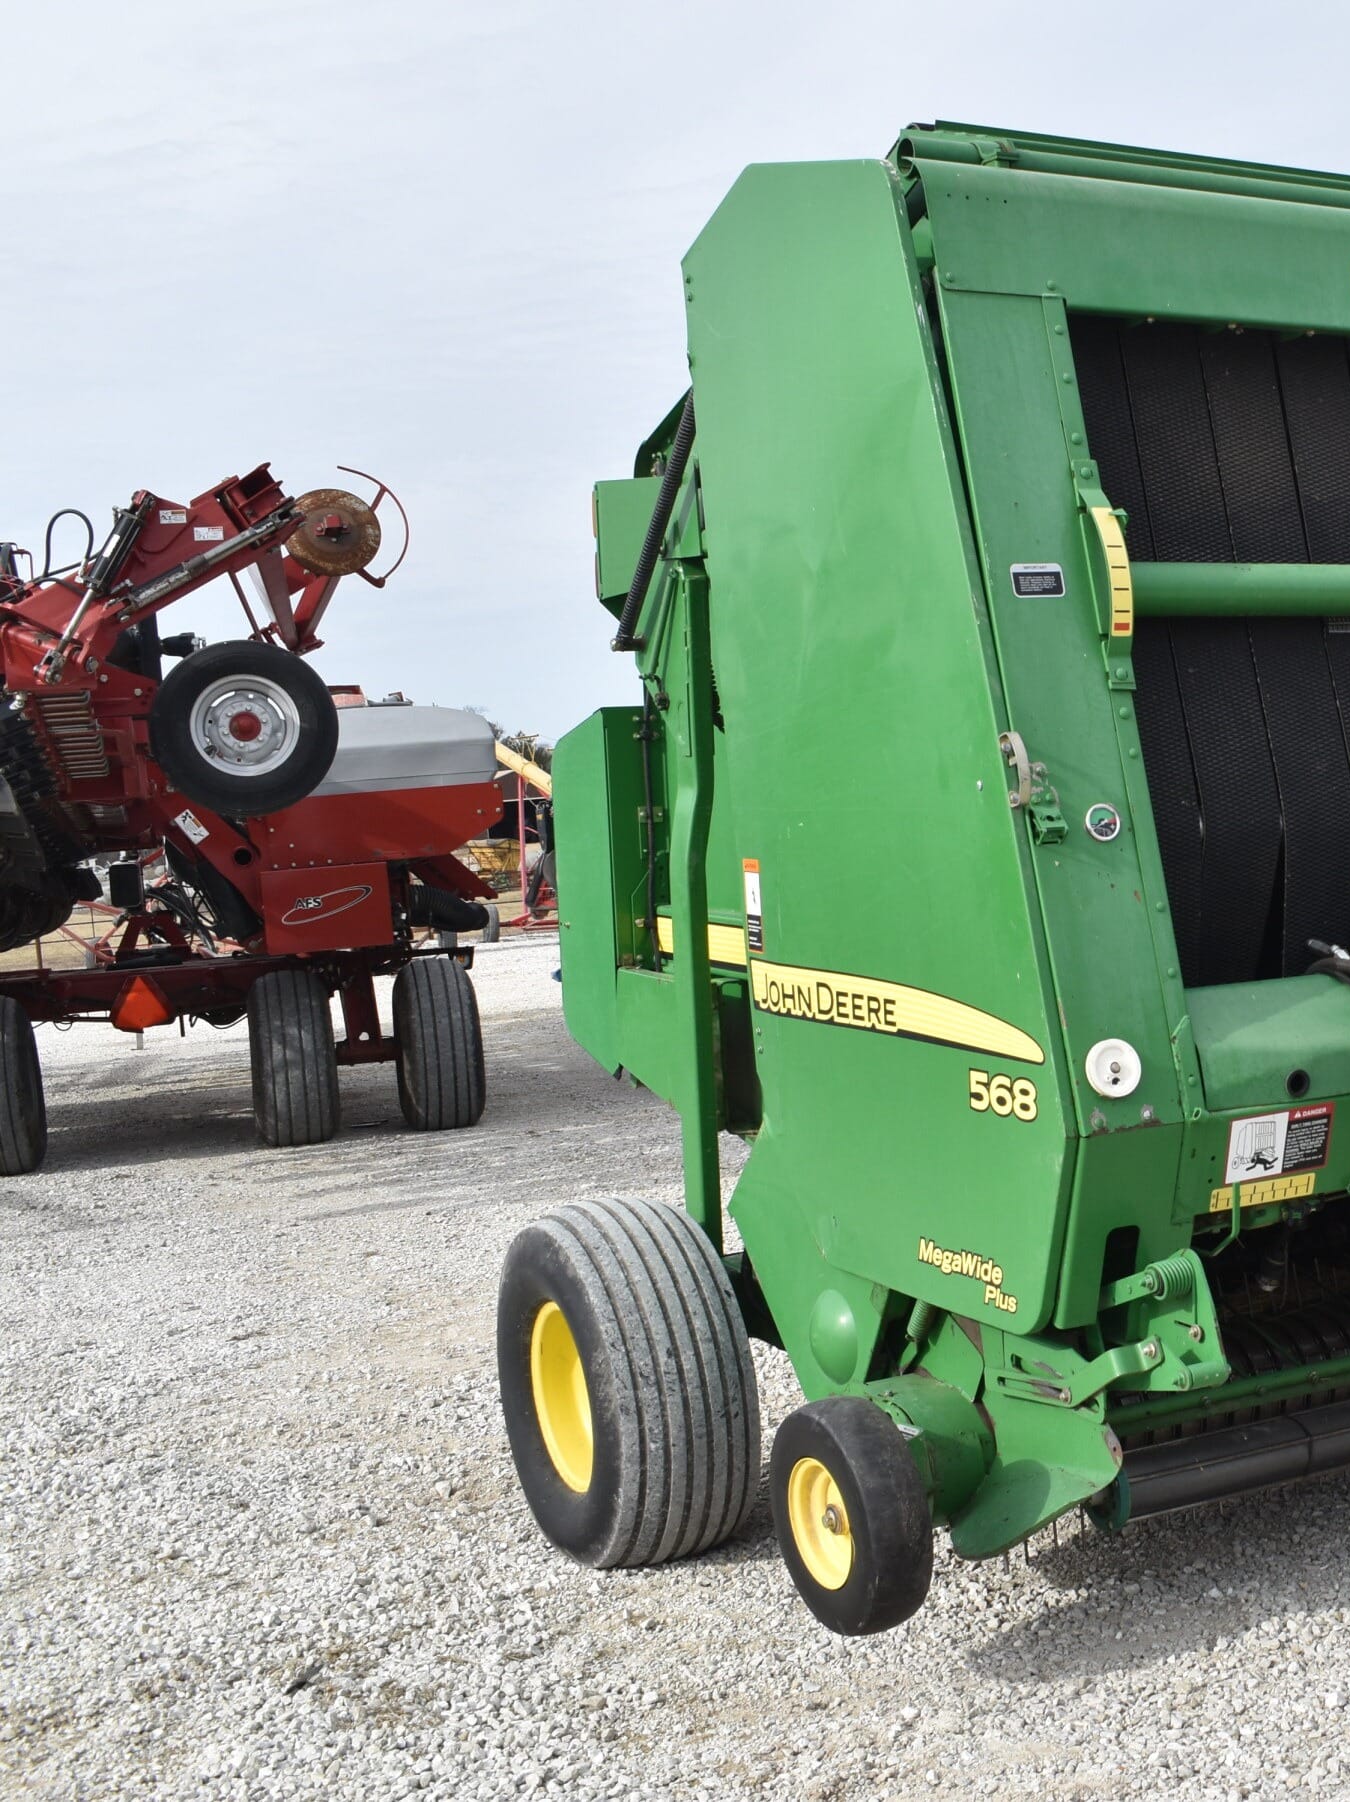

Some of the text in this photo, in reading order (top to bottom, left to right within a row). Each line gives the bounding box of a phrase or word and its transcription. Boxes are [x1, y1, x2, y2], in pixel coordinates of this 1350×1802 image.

[295, 897, 322, 909] AFS
[761, 972, 897, 1027] JOHN DEERE
[968, 1067, 1038, 1122] 568
[1302, 1107, 1327, 1117] DANGER
[917, 1236, 1003, 1286] MegaWide
[984, 1283, 1018, 1314] Plus
